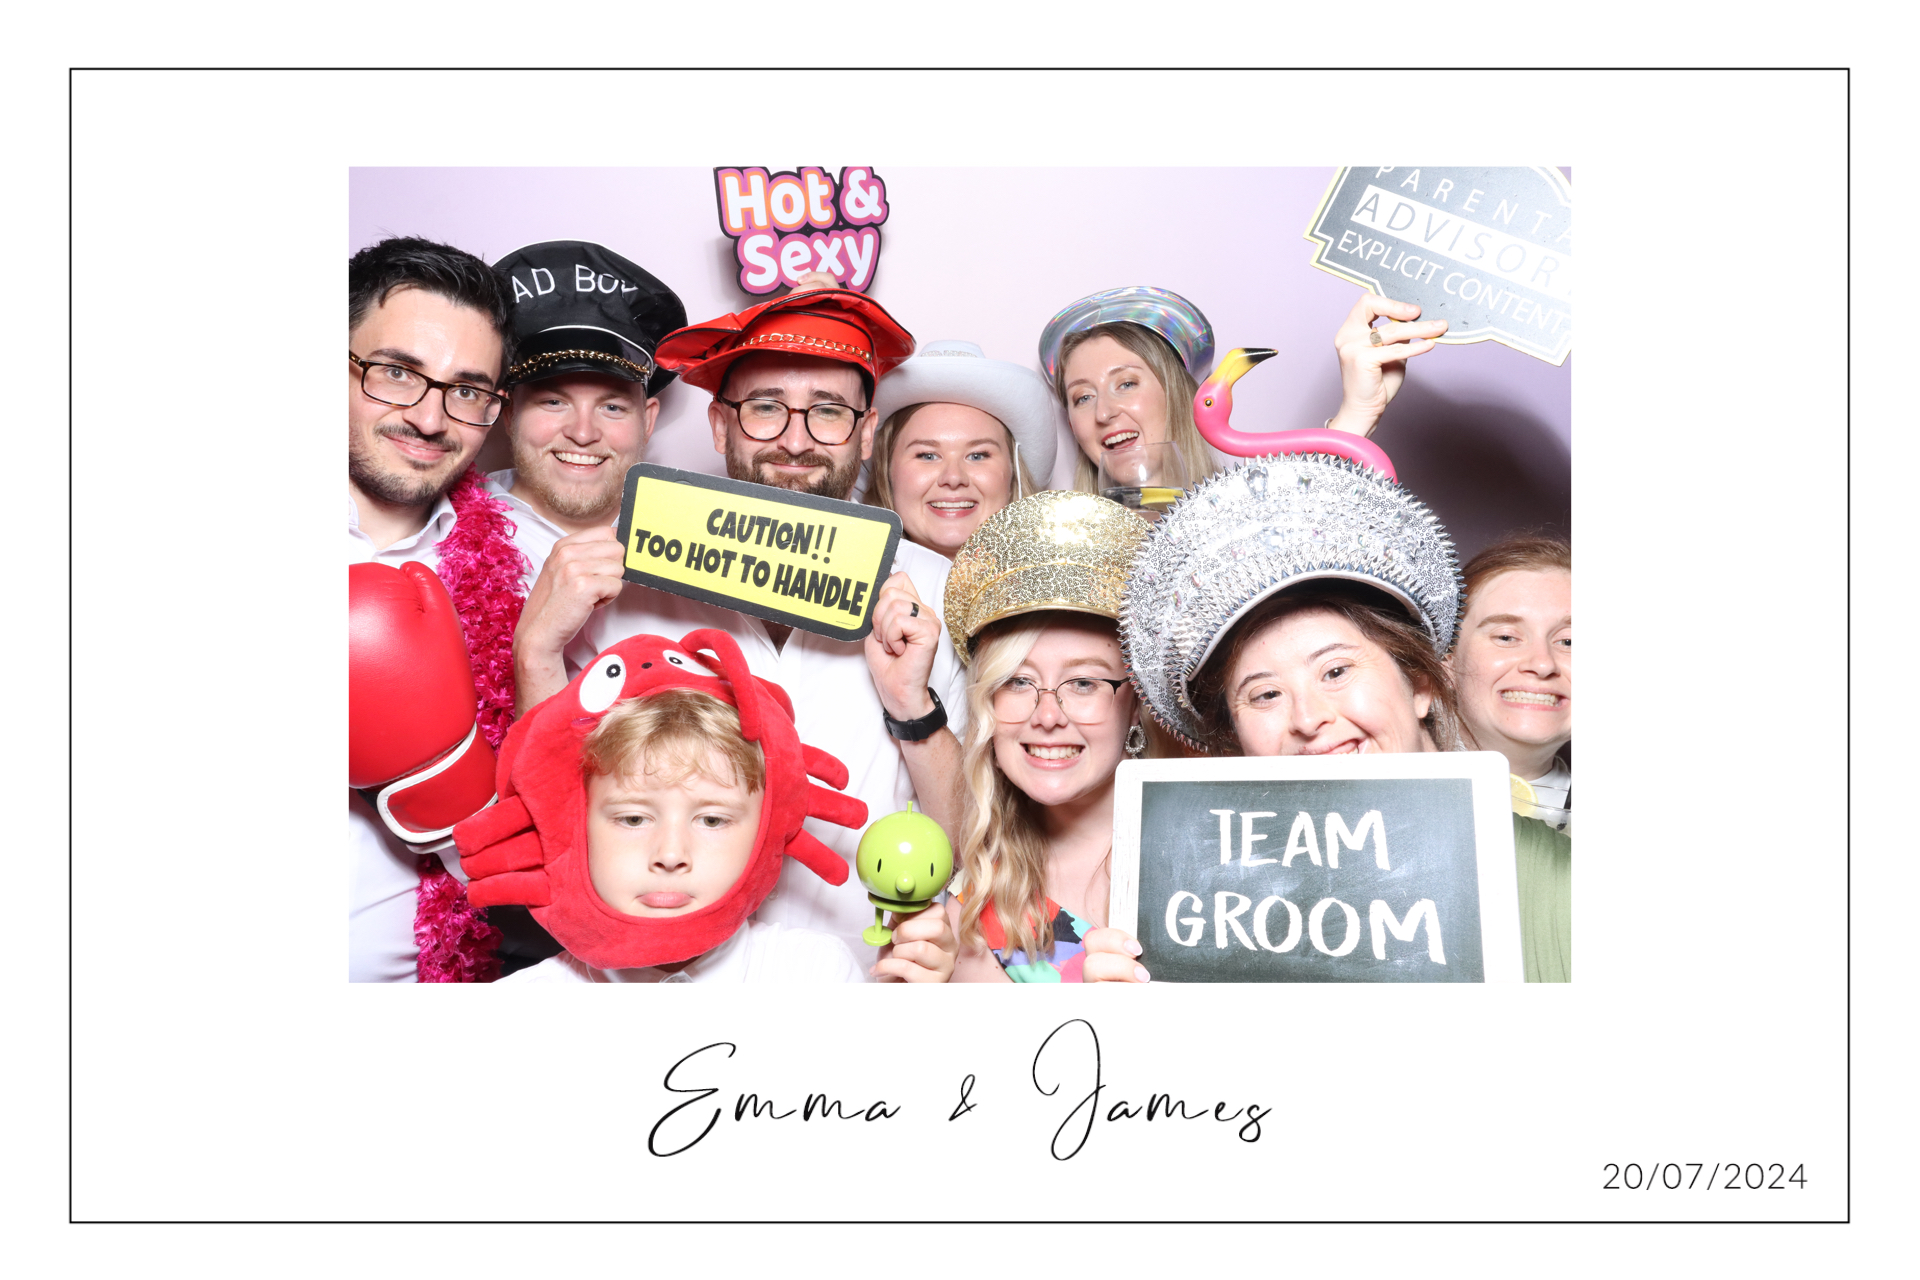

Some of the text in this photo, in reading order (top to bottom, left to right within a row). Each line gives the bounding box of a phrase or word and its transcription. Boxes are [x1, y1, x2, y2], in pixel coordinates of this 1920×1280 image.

[725, 169, 882, 229] Hot &
[743, 233, 874, 287] Sexy
[1354, 192, 1571, 296] ADVISOR
[1337, 229, 1571, 335] EXPLICIT CONTENT
[706, 508, 838, 564] CAUTION!!
[635, 528, 869, 617] TOO HOT TO HANDLE
[1209, 808, 1390, 871] TEAM
[1165, 889, 1446, 966] GROOM
